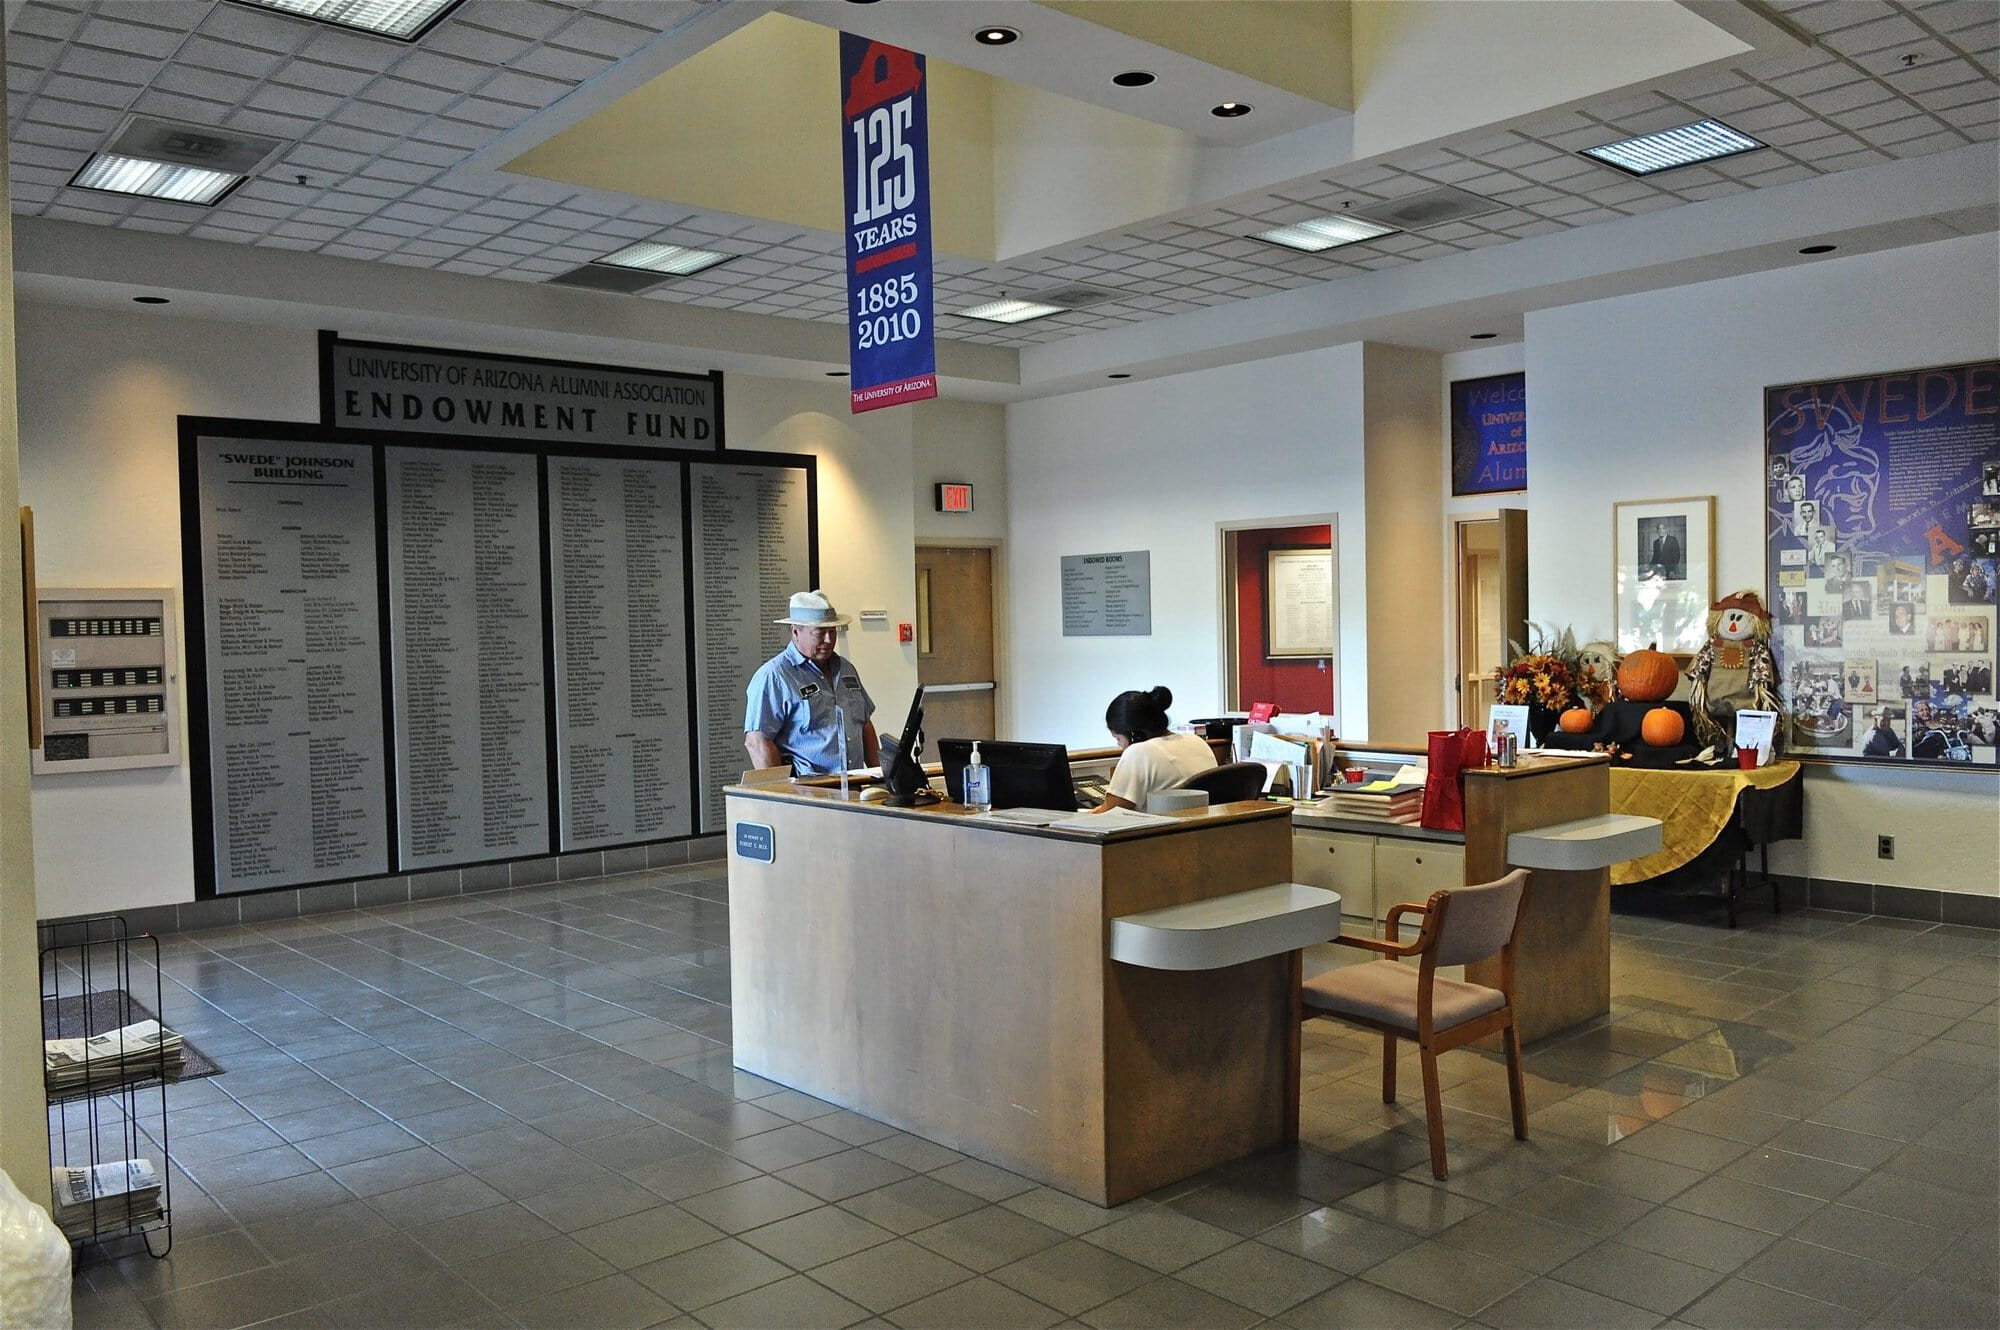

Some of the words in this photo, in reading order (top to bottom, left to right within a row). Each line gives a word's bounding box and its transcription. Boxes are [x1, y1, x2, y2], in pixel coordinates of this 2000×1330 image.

[853, 95, 916, 226] 125
[854, 212, 918, 254] YEARS
[857, 272, 919, 317] 1885
[858, 308, 921, 350] 2010
[347, 356, 443, 384] UNIVERSITY
[447, 365, 468, 386] OF
[473, 367, 545, 393] ARIZONA
[550, 375, 609, 399] ALUMNI
[613, 381, 705, 407] ASSOCIATION
[853, 392, 864, 402] THE
[864, 386, 894, 401] UNIVERSITY
[894, 383, 903, 394] OF
[345, 390, 597, 433] ENDOWMENT
[627, 412, 711, 441] FUND
[219, 453, 281, 466] "SWEDE"
[285, 456, 355, 468] JOHNSON
[254, 468, 324, 480] BUILDING
[945, 487, 968, 508] EXIT
[1083, 555, 1105, 565] ENDOWED
